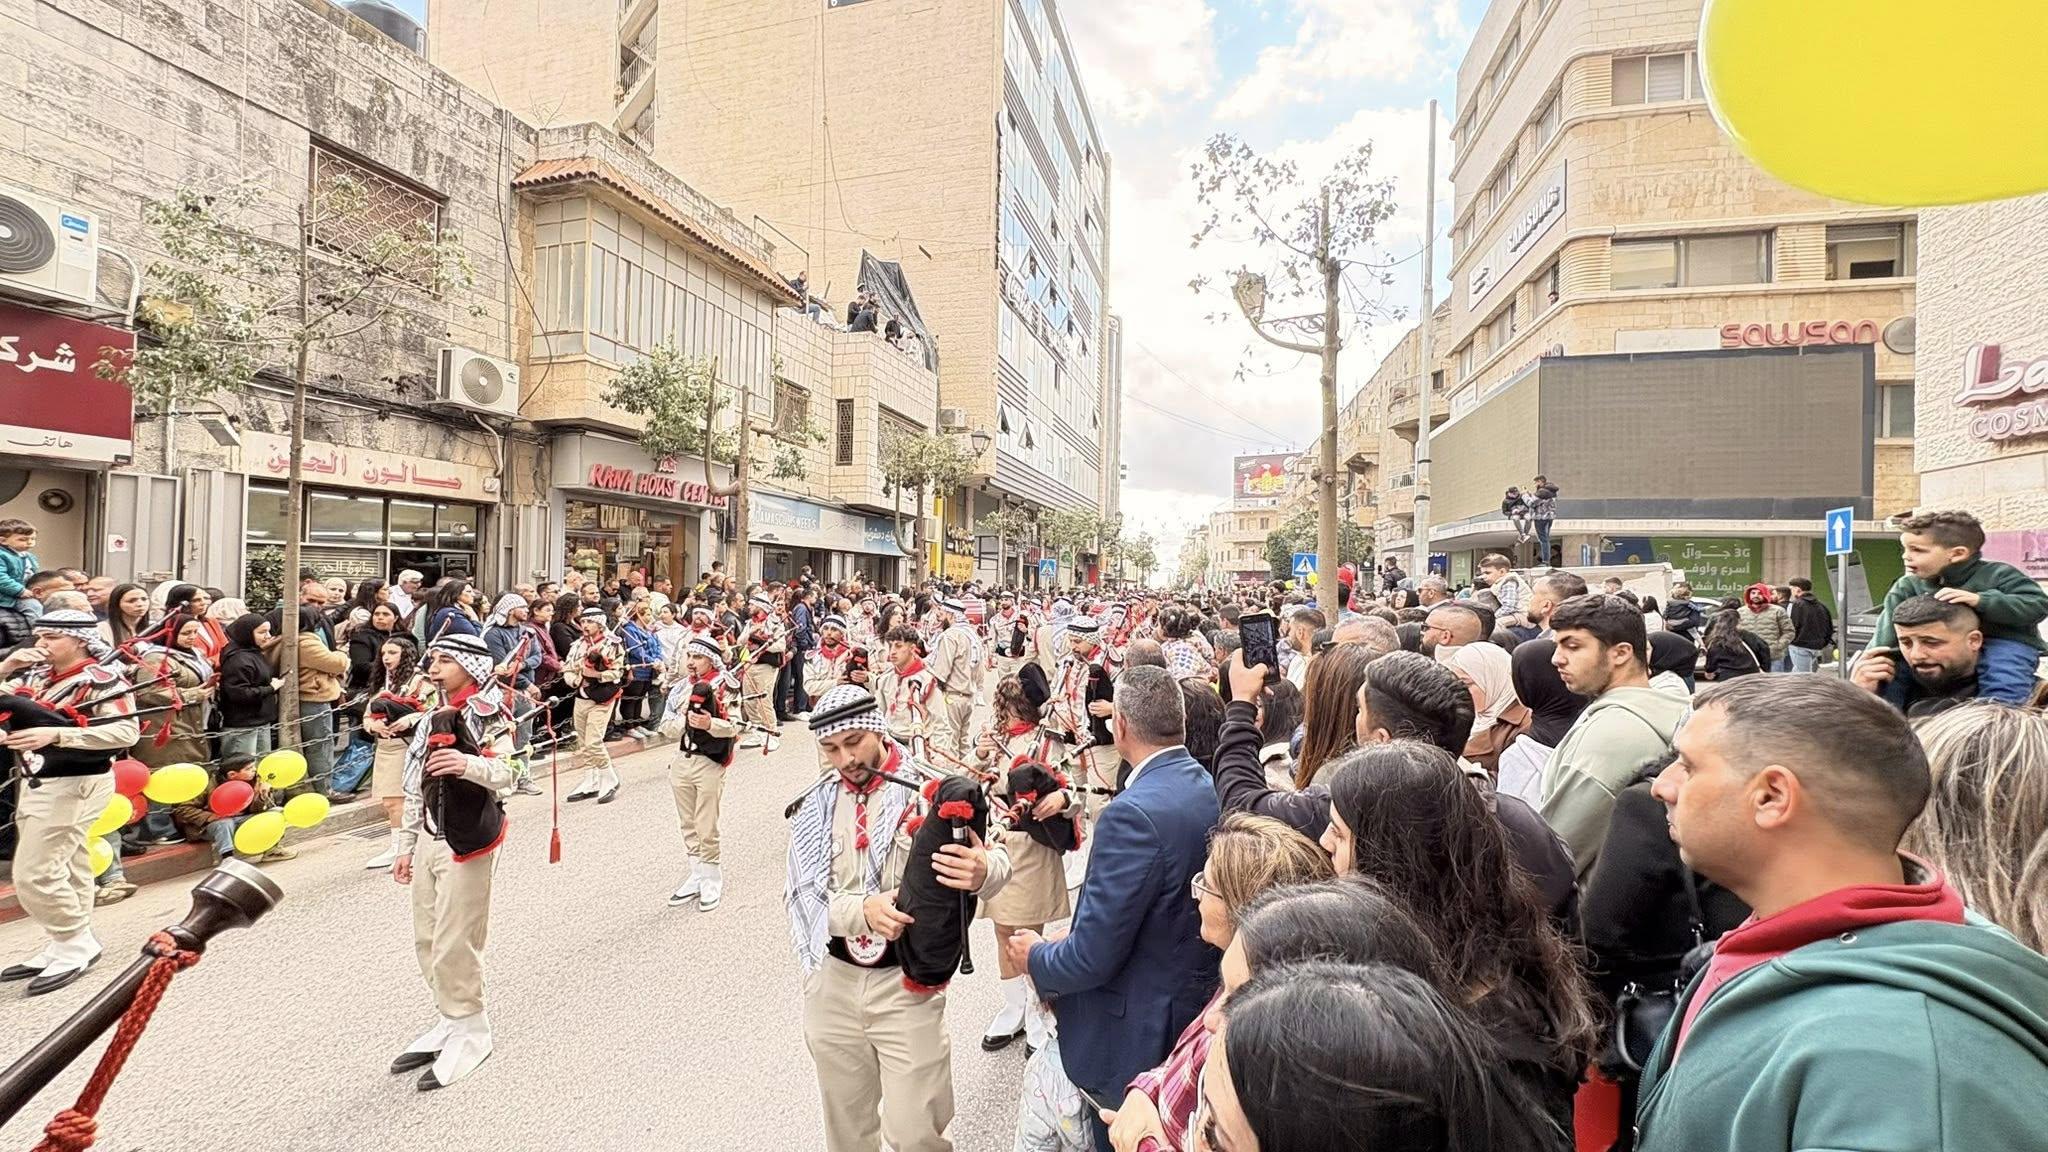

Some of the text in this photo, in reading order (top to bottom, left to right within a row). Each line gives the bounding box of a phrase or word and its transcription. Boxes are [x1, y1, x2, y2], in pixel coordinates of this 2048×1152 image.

[1507, 186, 1560, 252] SAMSUNG
[7, 435, 73, 448] هاتف
[592, 463, 634, 492] RANA
[1734, 548, 1750, 557] 3G
